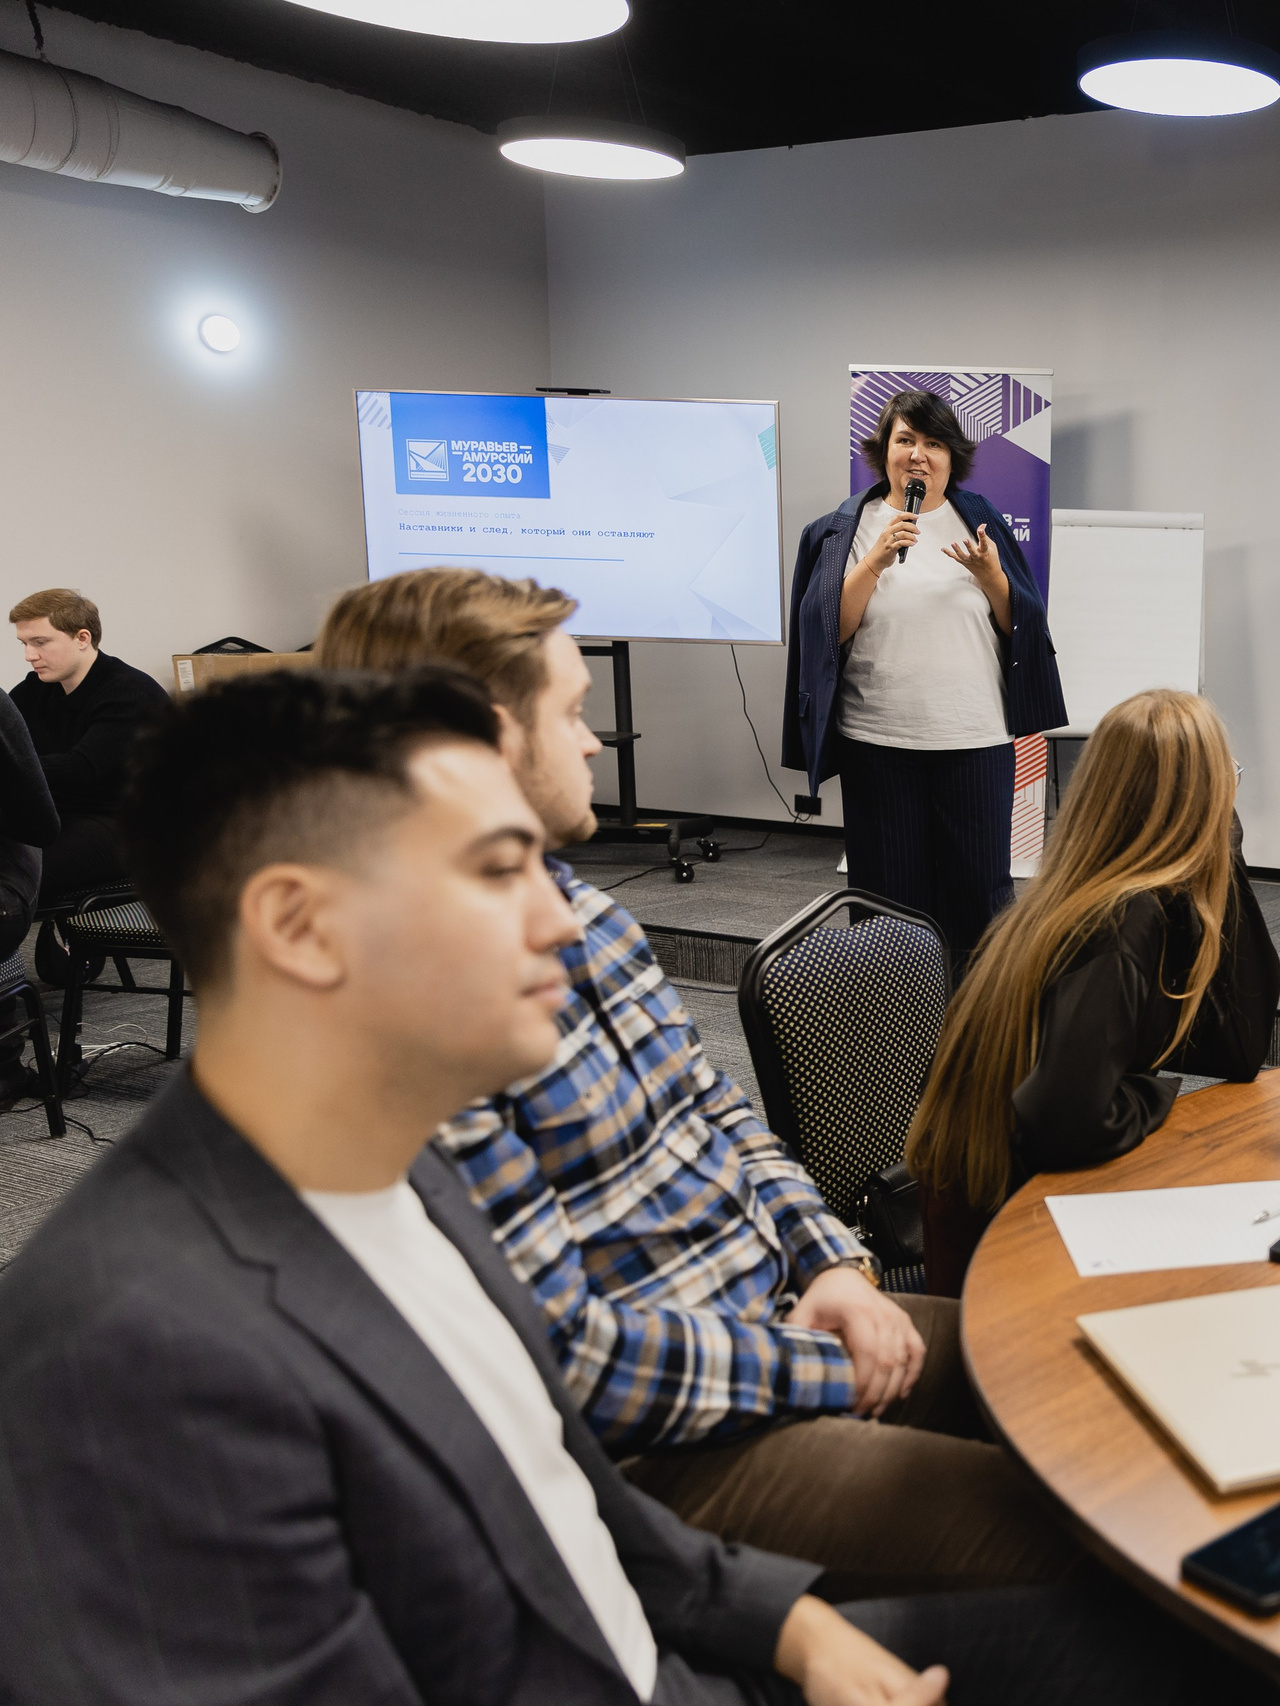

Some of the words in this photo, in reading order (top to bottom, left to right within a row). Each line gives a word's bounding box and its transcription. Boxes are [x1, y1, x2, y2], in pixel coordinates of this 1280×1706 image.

[462, 463, 523, 484] 2030
[398, 508, 430, 516] Сессия
[435, 510, 489, 518] жизненного
[494, 511, 521, 519] опыта
[399, 522, 463, 533] Наставники
[482, 526, 513, 535] след,
[521, 527, 565, 537] который
[572, 529, 591, 537] они
[597, 530, 655, 539] оставляют
